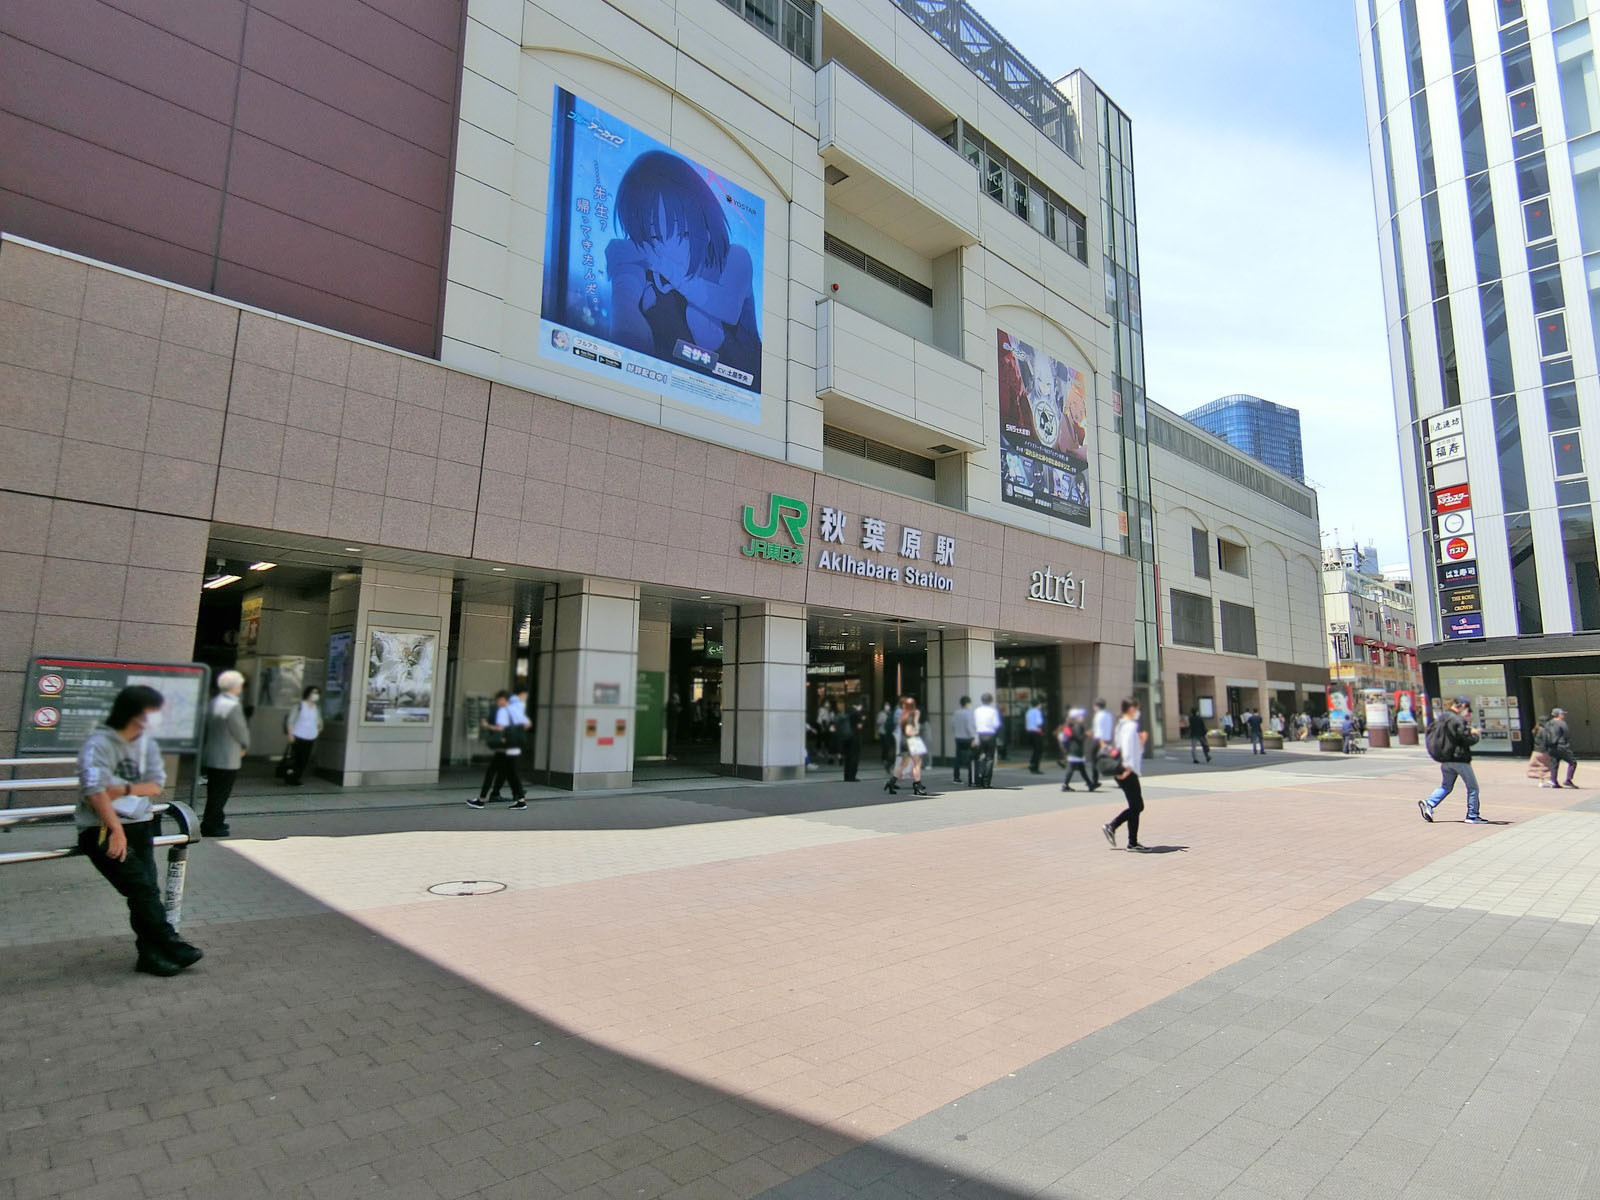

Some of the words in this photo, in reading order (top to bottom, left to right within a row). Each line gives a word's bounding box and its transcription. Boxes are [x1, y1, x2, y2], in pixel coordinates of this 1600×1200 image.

[733, 199, 757, 215] YOSTAR
[681, 344, 712, 366] ミサキ
[743, 493, 809, 546] JR
[821, 506, 956, 567] 秋葉原駅
[742, 538, 804, 565] JR東日本
[1449, 546, 1467, 555] ガスト
[819, 549, 899, 582] Akihabara
[905, 565, 954, 592] Station
[1446, 567, 1475, 579] はま寿司
[1031, 565, 1076, 604] atré
[1454, 604, 1473, 612] CROWN
